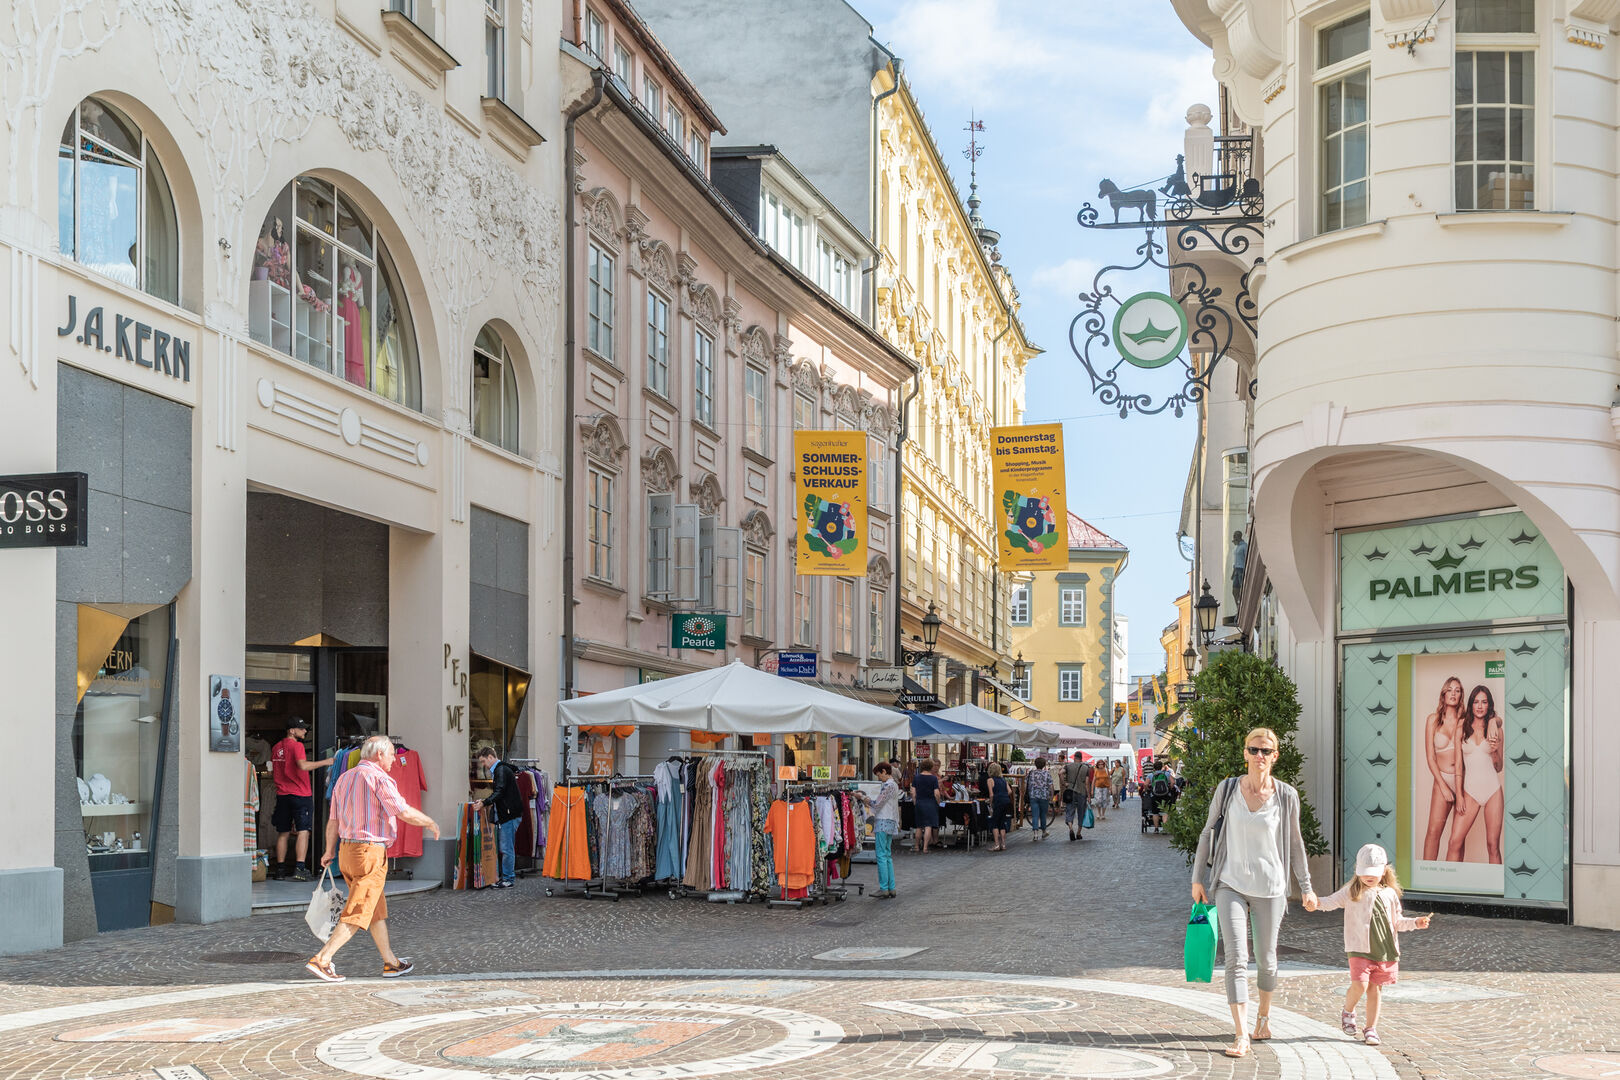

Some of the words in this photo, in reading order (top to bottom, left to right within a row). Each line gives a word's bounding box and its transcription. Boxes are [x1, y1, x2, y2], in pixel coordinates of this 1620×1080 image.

[997, 433, 1056, 444] Donnerstag
[996, 447, 1010, 455] bis
[1012, 445, 1059, 455] Samstag.
[802, 453, 862, 463] SOMMER-
[802, 466, 862, 476] SCHLUSS-
[803, 478, 859, 488] VERKAUF
[25, 524, 67, 534] BOSS
[1369, 565, 1540, 601] PALMERS
[682, 636, 715, 647] Pearle
[871, 672, 899, 684] Carletta
